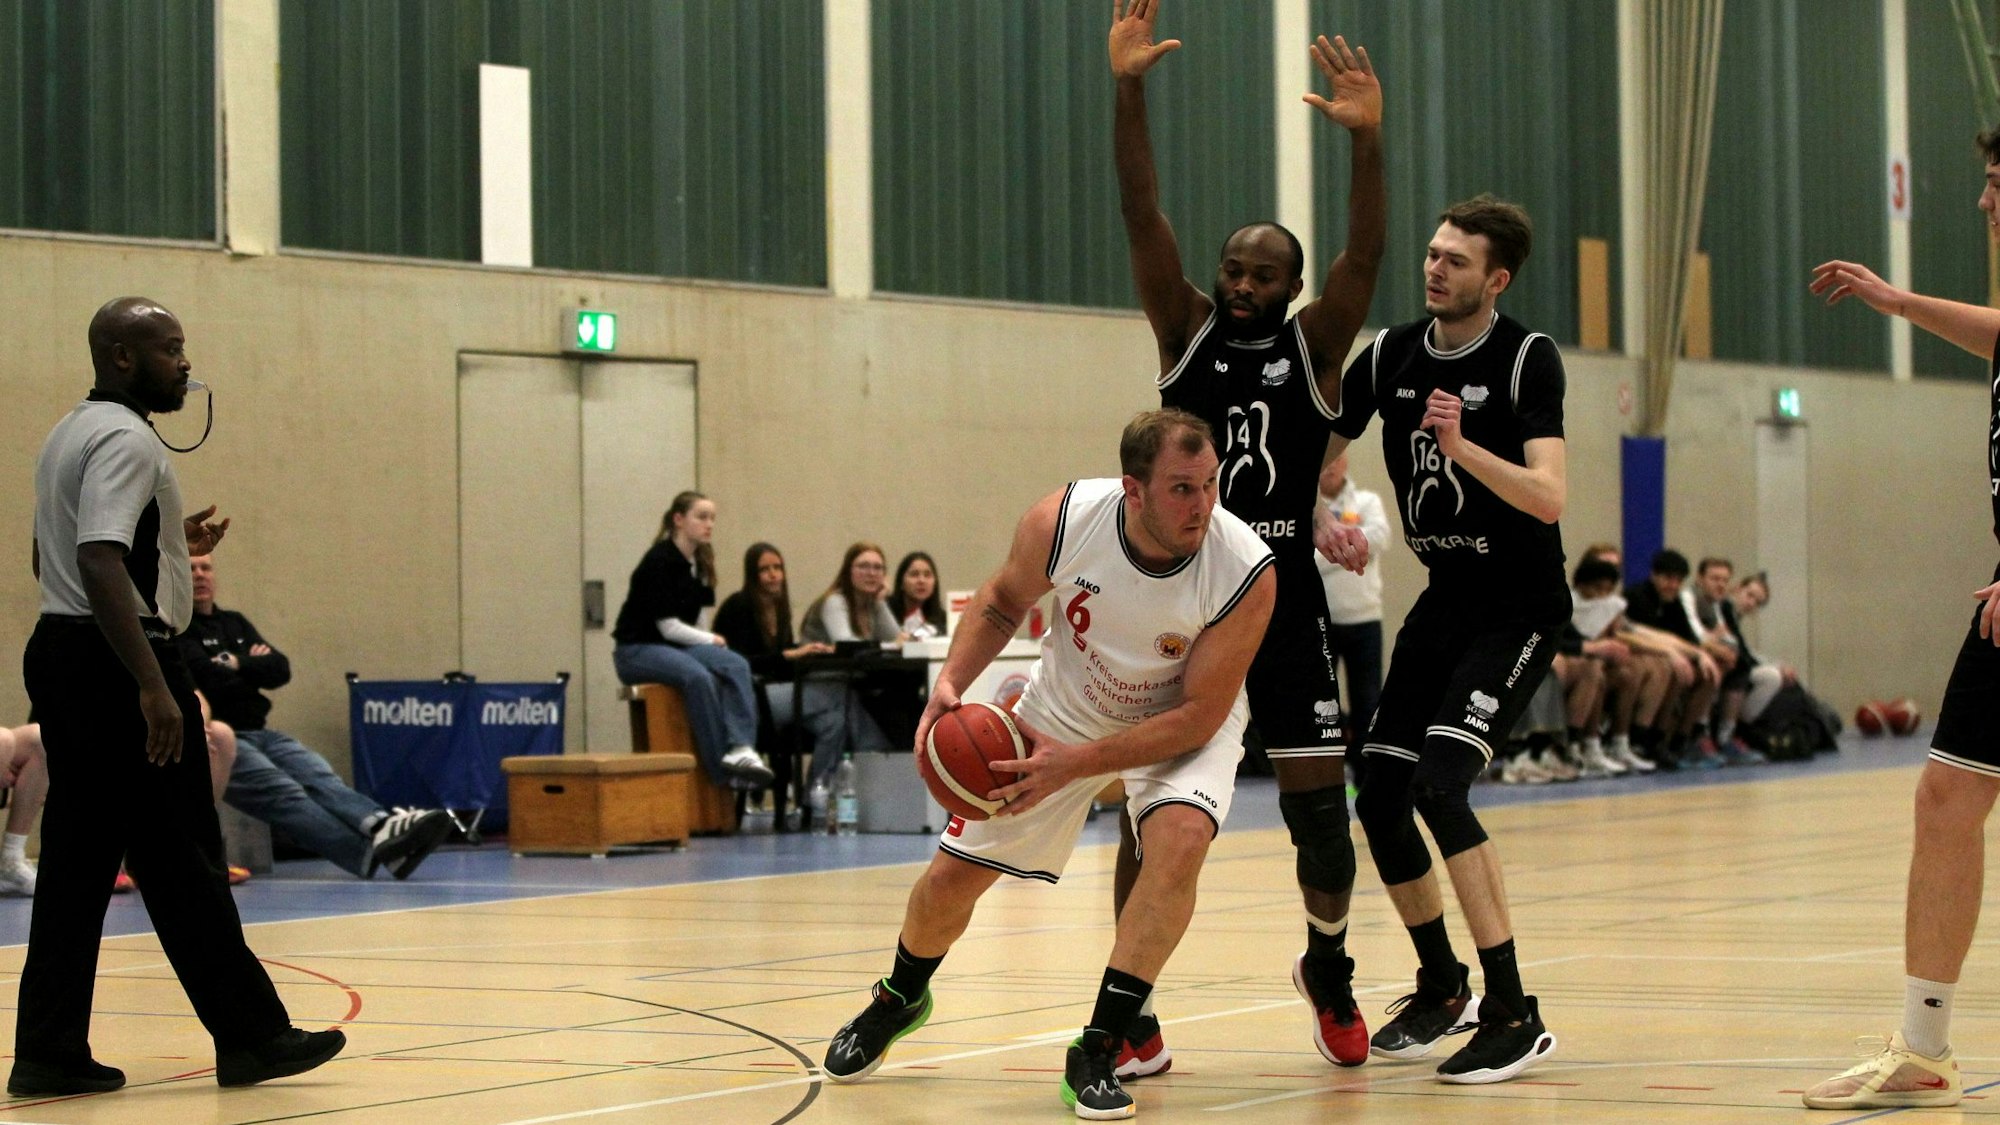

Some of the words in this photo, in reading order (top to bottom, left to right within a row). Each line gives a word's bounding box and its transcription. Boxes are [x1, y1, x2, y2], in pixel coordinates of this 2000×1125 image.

[1892, 162, 1905, 210] 3
[1419, 441, 1440, 472] 16
[1074, 576, 1100, 595] JAKO
[1066, 589, 1091, 634] 6
[1089, 650, 1182, 692] Kreissparkasse
[364, 697, 453, 726] molten
[481, 697, 559, 725] molten
[1463, 714, 1490, 733] JAKO
[1321, 728, 1342, 739] JAKO
[1193, 789, 1218, 809] JAKO
